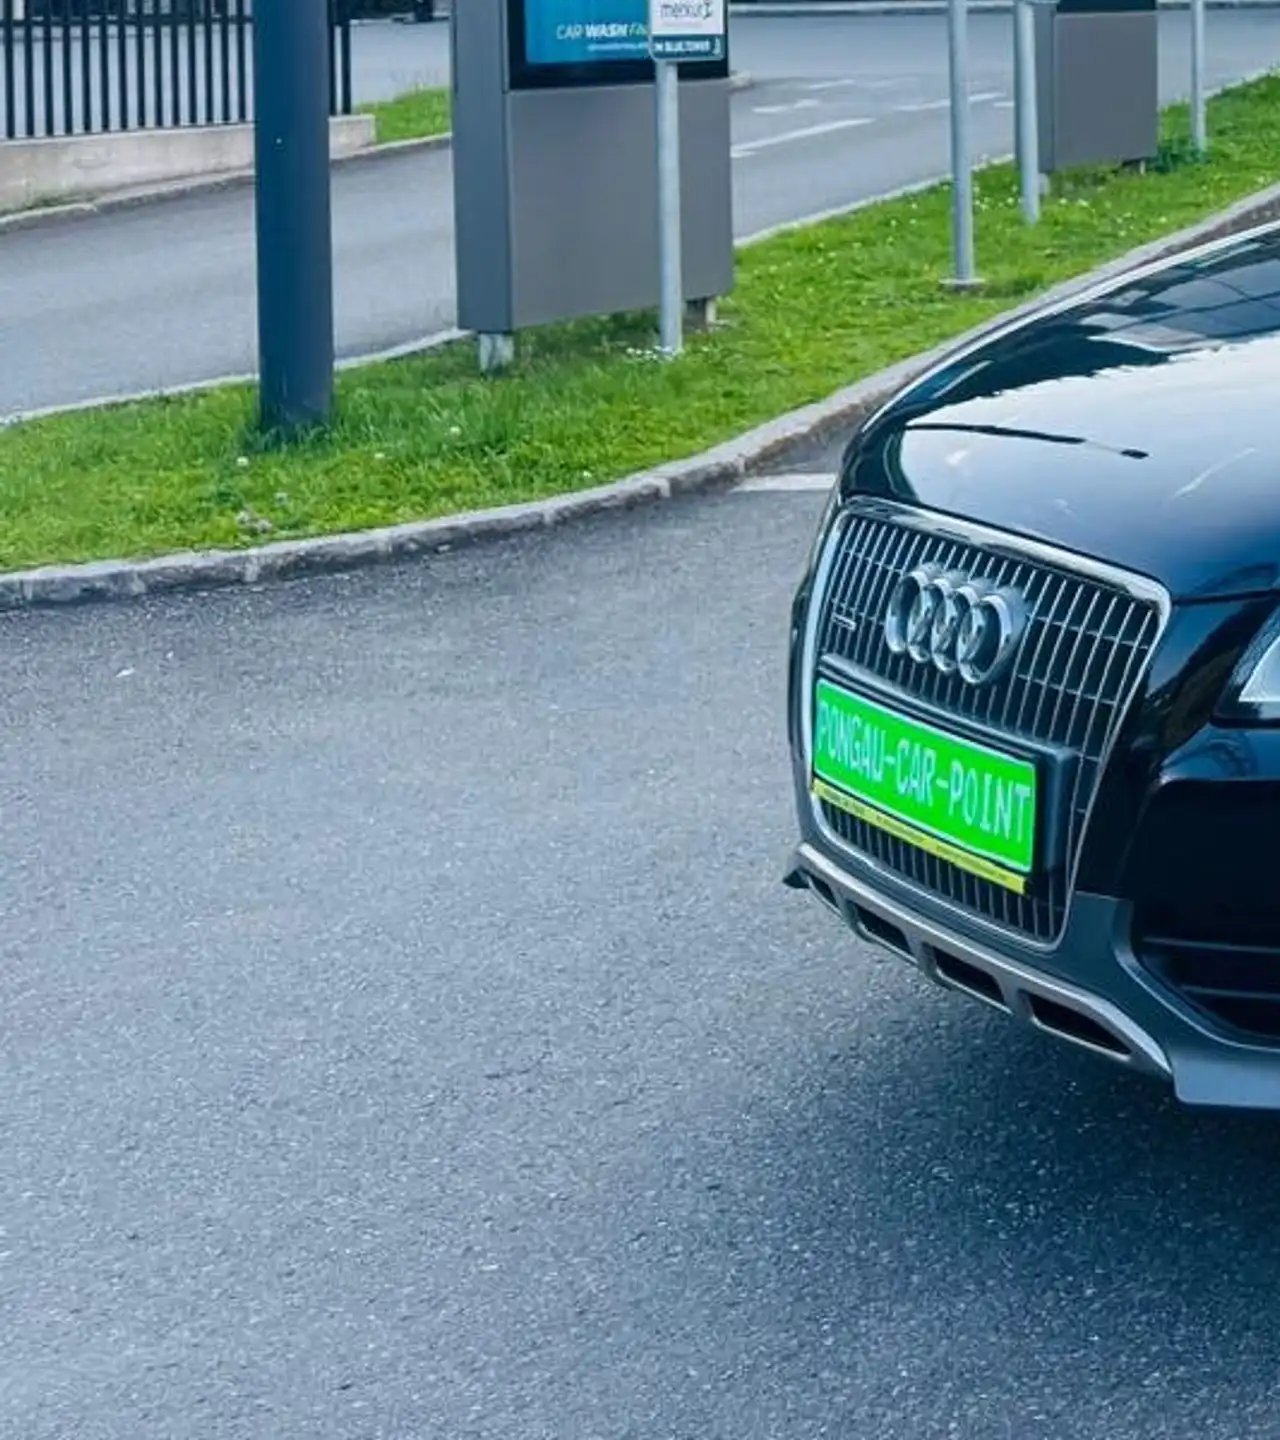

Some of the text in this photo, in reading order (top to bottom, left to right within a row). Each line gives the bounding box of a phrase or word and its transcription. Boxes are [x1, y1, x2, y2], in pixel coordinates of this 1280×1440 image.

[556, 24, 582, 40] CAR
[585, 23, 629, 39] WASH
[817, 699, 1032, 844] PONGAU-CAR-POINT
